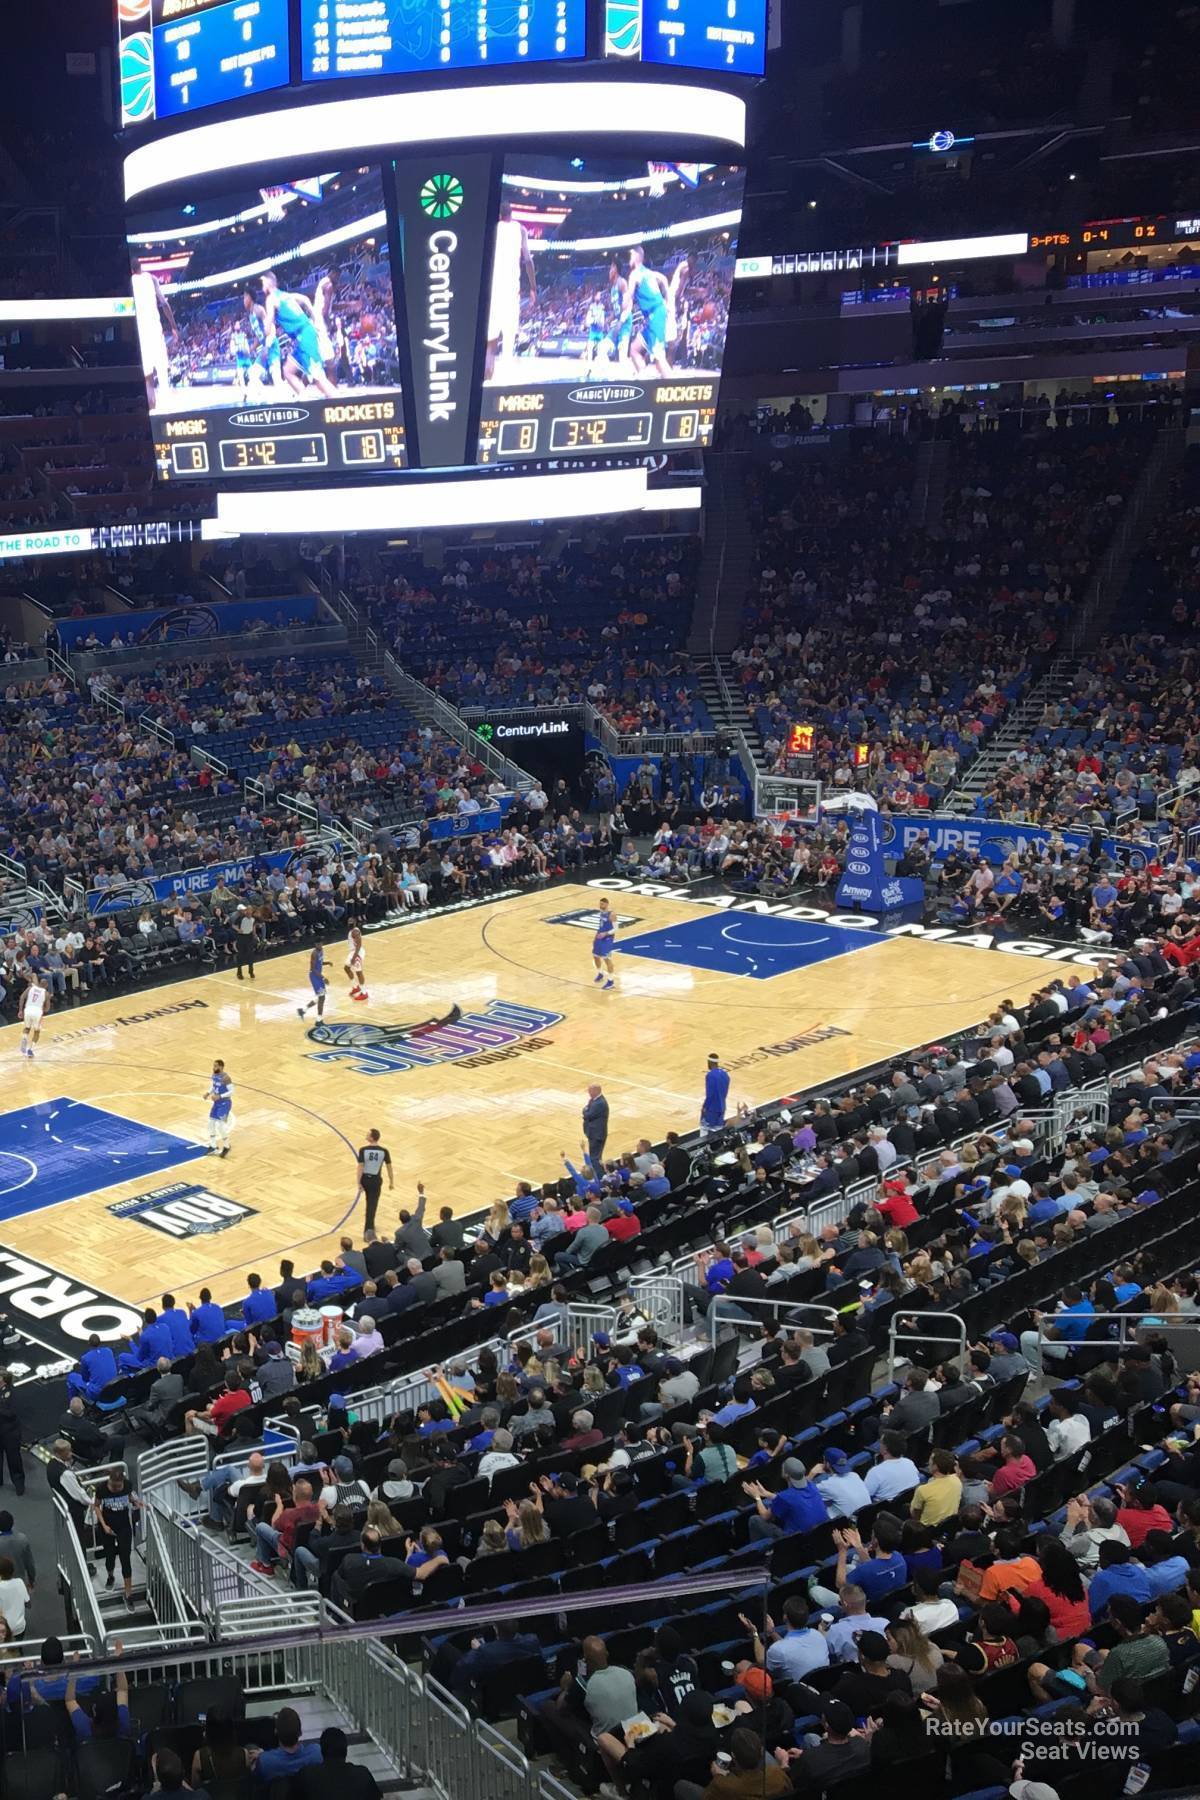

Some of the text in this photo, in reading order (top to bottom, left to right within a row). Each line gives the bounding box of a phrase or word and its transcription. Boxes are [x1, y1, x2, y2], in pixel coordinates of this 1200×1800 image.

[668, 37, 676, 57] 1
[726, 44, 734, 64] 2
[244, 67, 252, 87] 2
[180, 85, 188, 104] 1
[1031, 234, 1070, 247] 3-PTS:
[742, 258, 858, 275] TO GEORGIA
[423, 230, 458, 422] CenturyLink
[498, 394, 544, 412] MAGIC
[656, 385, 712, 403] ROCKETS
[325, 402, 394, 423] ROCKETS
[166, 419, 207, 437] MAGIC
[520, 425, 531, 449] 8
[567, 420, 606, 446] 3:42
[192, 447, 202, 468] 8
[236, 442, 275, 466] 3:42
[26, 537, 60, 549] ROAD
[64, 535, 80, 545] TO
[497, 721, 569, 737] CenturyLink
[173, 873, 209, 892] PURE
[842, 884, 872, 897] Amway
[587, 877, 879, 928] ORLANDO
[887, 923, 1131, 968] MAGIC
[758, 1025, 853, 1057] Amway
[139, 1192, 250, 1236] RDV
